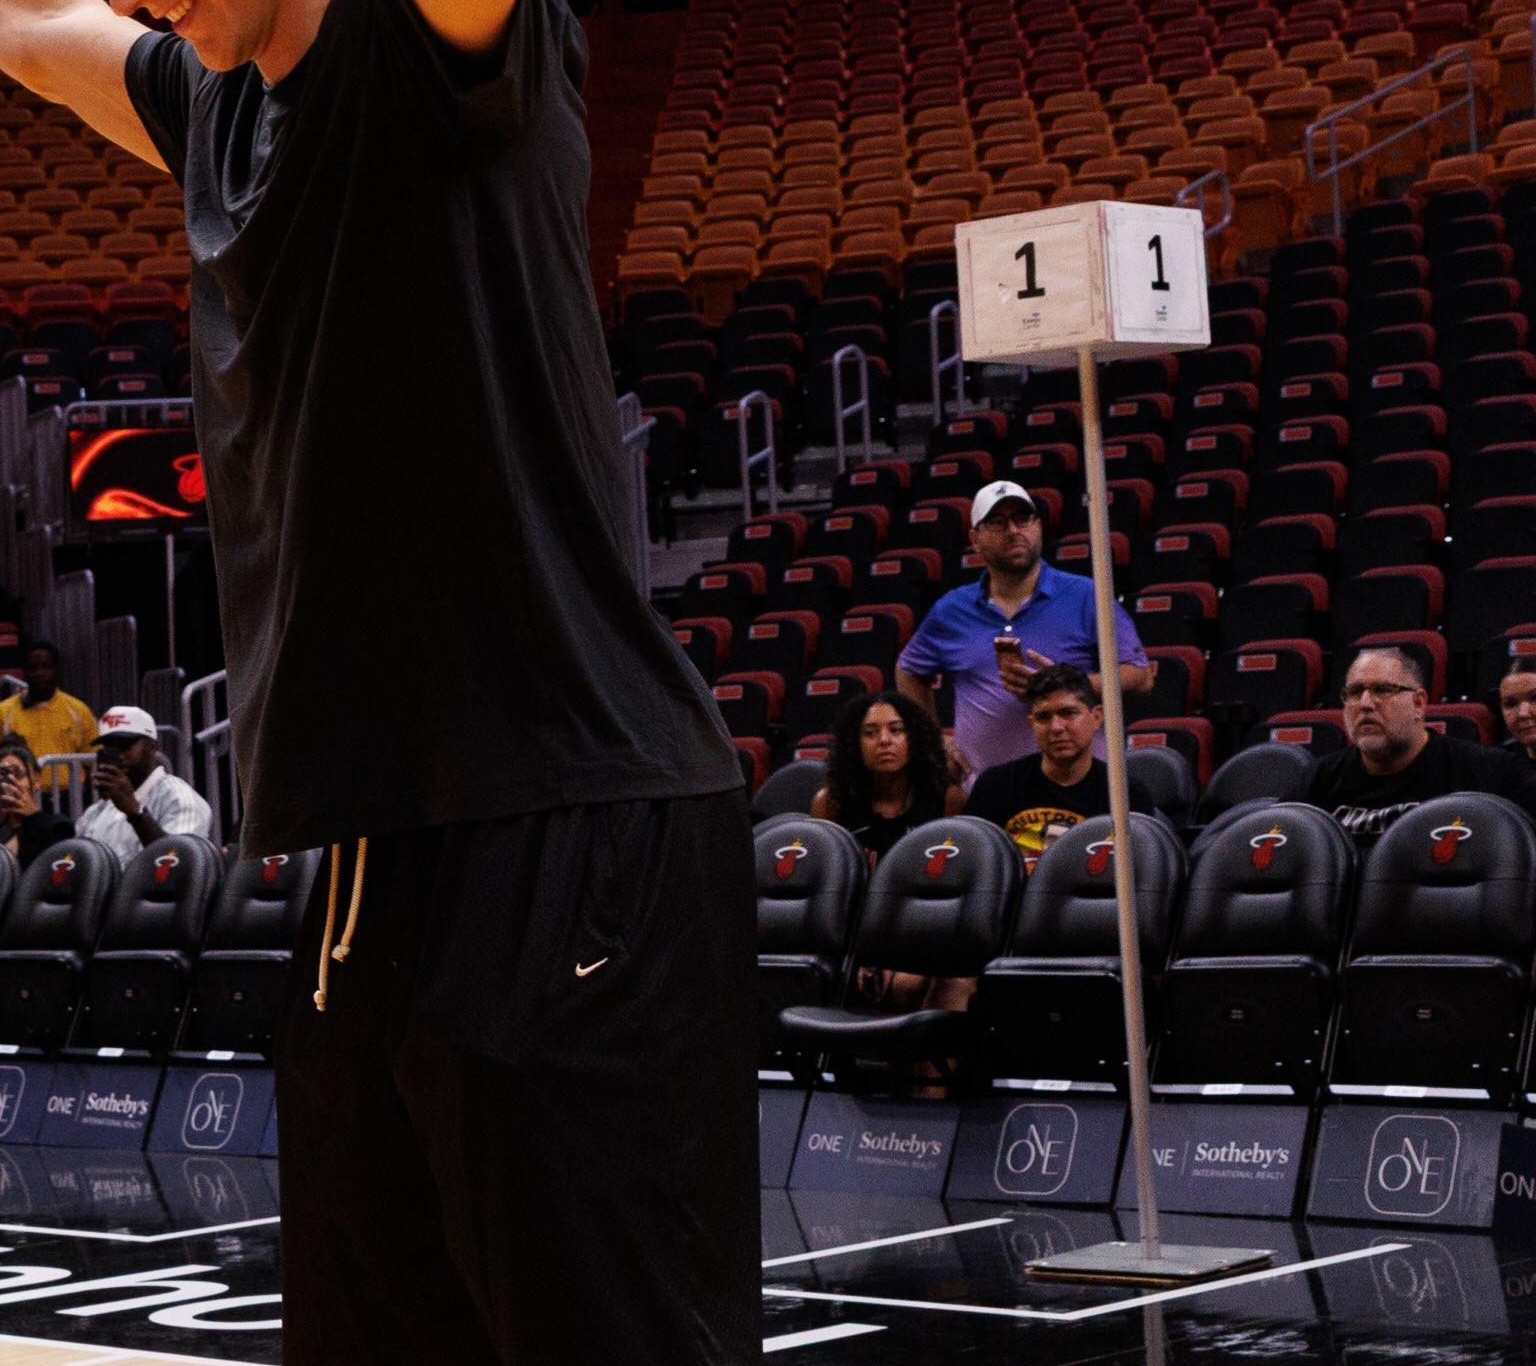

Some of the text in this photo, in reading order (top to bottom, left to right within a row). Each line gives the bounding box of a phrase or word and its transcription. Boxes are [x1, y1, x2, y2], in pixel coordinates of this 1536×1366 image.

[1015, 241, 1046, 300] 1
[1148, 234, 1170, 291] 1
[47, 1092, 148, 1119] ONE Sotheby's
[807, 1131, 943, 1159] ONE Sotheby's
[1006, 1123, 1064, 1176] ONE
[1152, 1141, 1291, 1170] NE Sotheby's
[1377, 1137, 1445, 1196] ONE
[1499, 1171, 1536, 1201] ON
